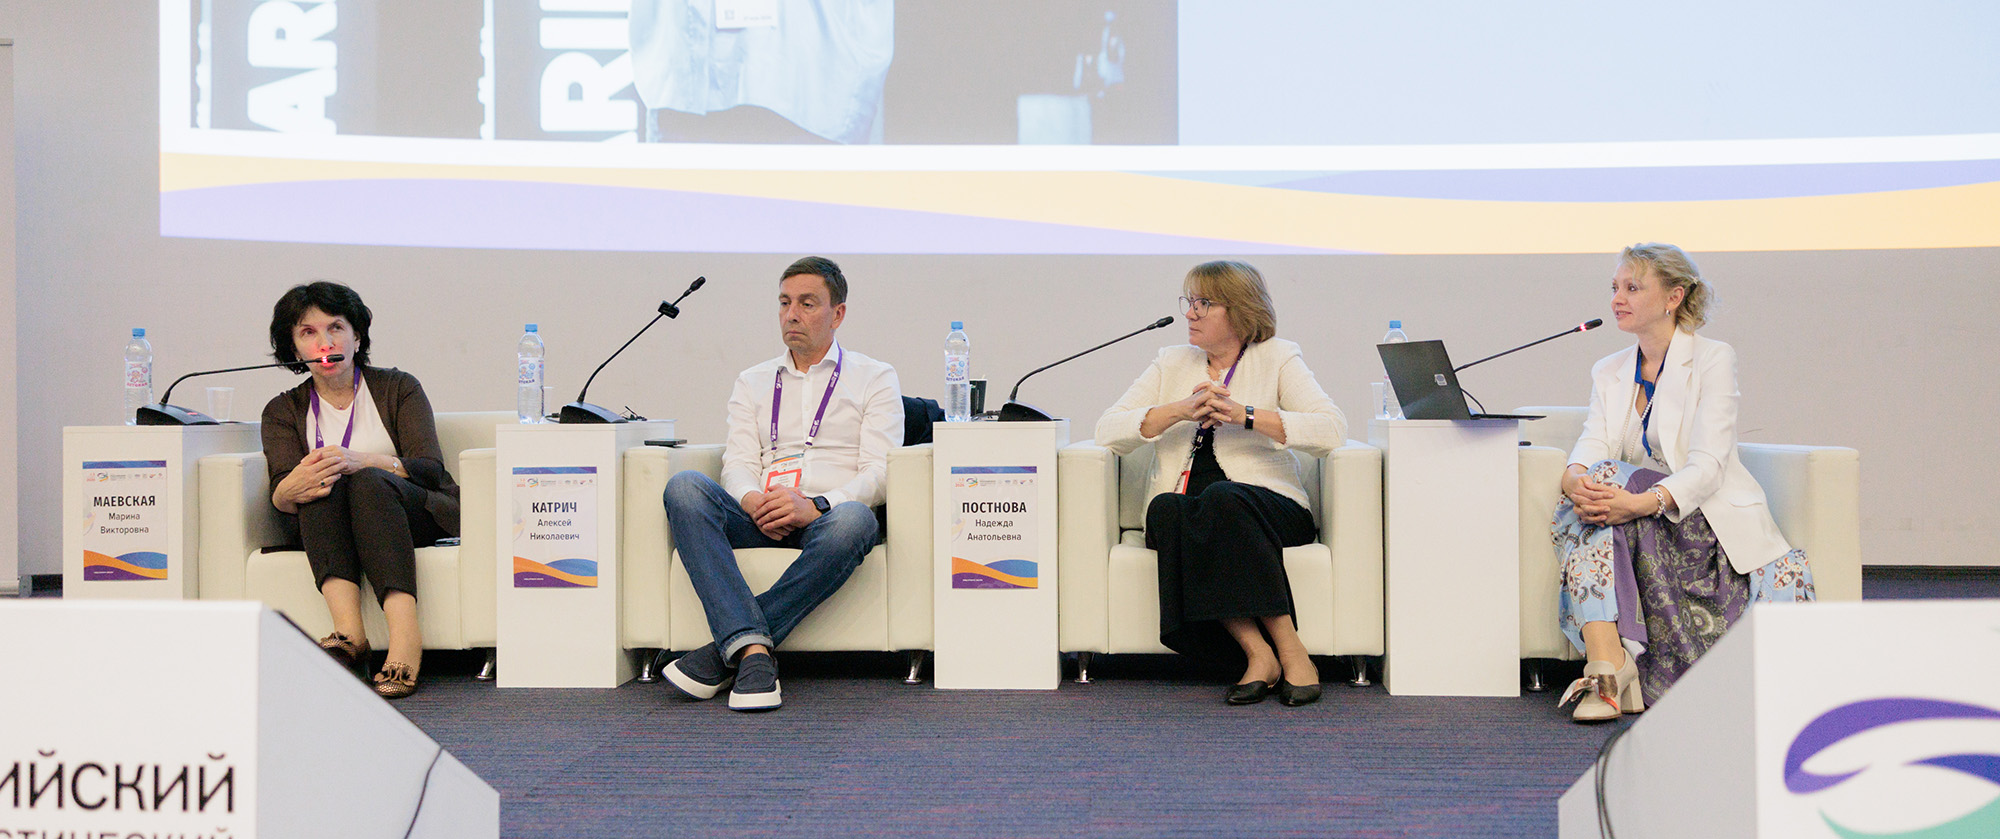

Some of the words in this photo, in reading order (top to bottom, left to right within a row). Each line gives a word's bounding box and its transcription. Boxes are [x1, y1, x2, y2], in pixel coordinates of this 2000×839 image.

[93, 495, 156, 507] МАЕВСКАЯ
[532, 502, 577, 513] КАТРИЧ
[962, 502, 1027, 513] ПОСТНОВА
[108, 512, 141, 522] Марина
[537, 518, 572, 527] Алексей
[975, 519, 1014, 528] Надежда
[100, 526, 149, 535] Викторовна
[529, 532, 580, 541] Николаевич
[967, 532, 1022, 541] Анатольевна
